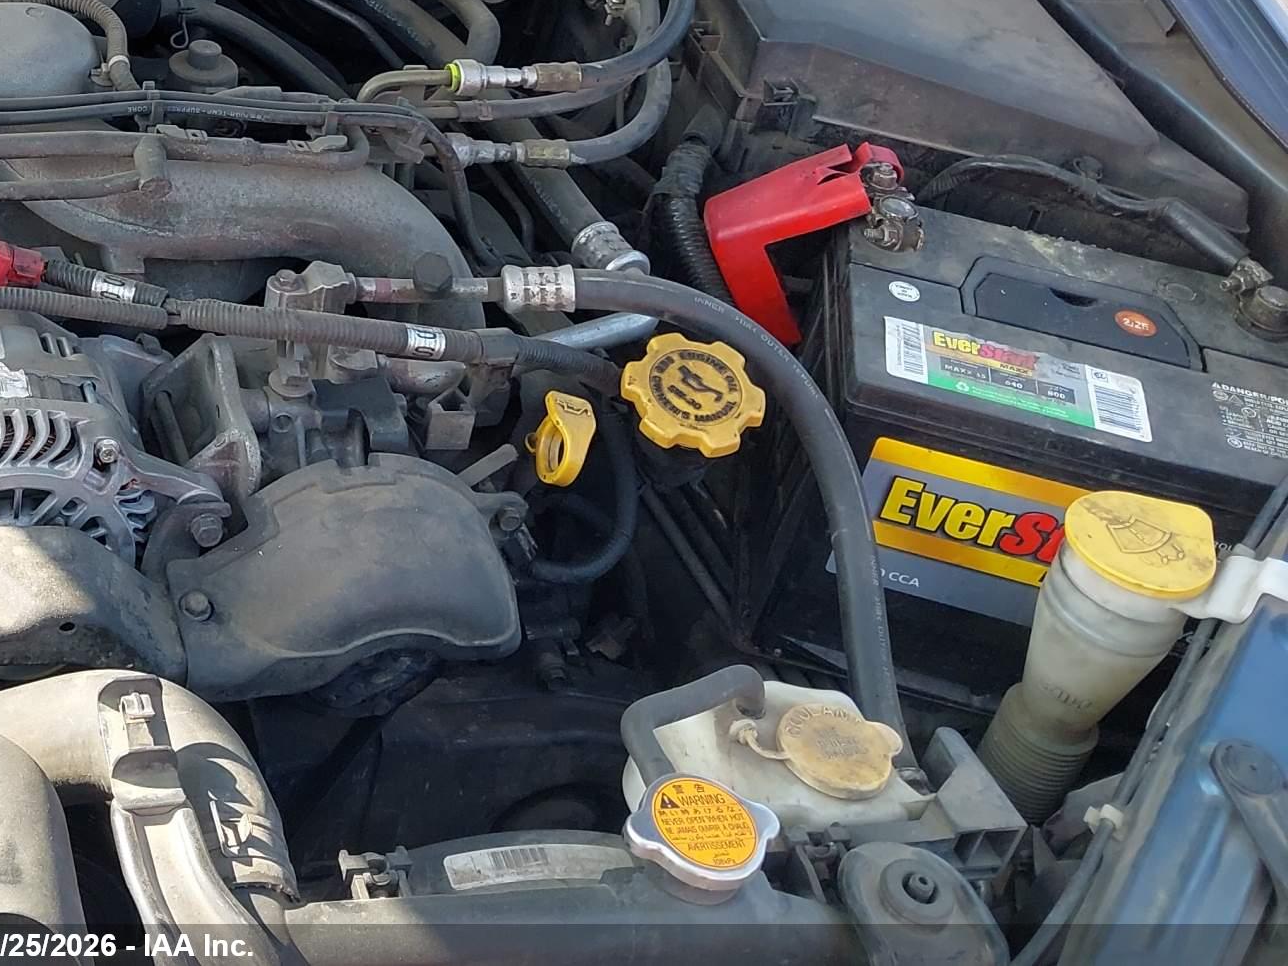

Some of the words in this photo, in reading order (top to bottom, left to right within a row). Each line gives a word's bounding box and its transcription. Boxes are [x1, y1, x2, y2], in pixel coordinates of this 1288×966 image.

[760, 334, 791, 363] OUTER
[888, 571, 921, 588] CCA
[677, 793, 726, 806] WARNING
[661, 817, 685, 826] NEVER
[686, 816, 704, 825] OPEN
[705, 814, 729, 824] WHEN
[688, 840, 746, 851] AVERTISSEMENT
